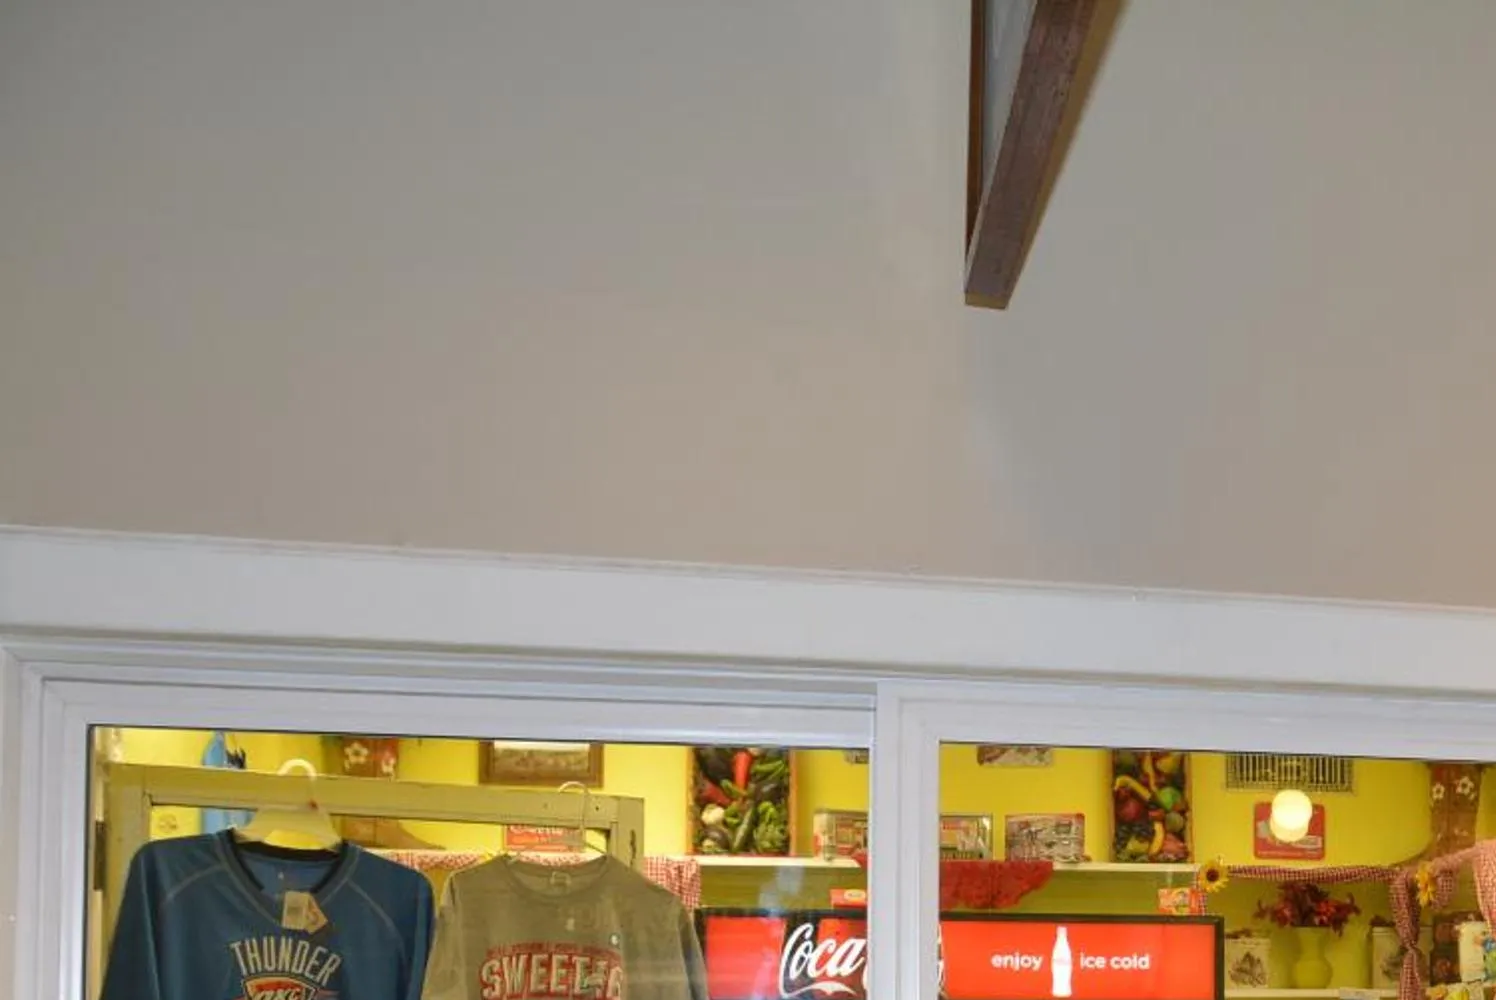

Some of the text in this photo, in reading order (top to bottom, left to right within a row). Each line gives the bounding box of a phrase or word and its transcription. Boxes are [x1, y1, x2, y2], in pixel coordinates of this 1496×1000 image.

[229, 936, 342, 987] THUNDER
[991, 951, 1151, 971] enjoy ice cold
